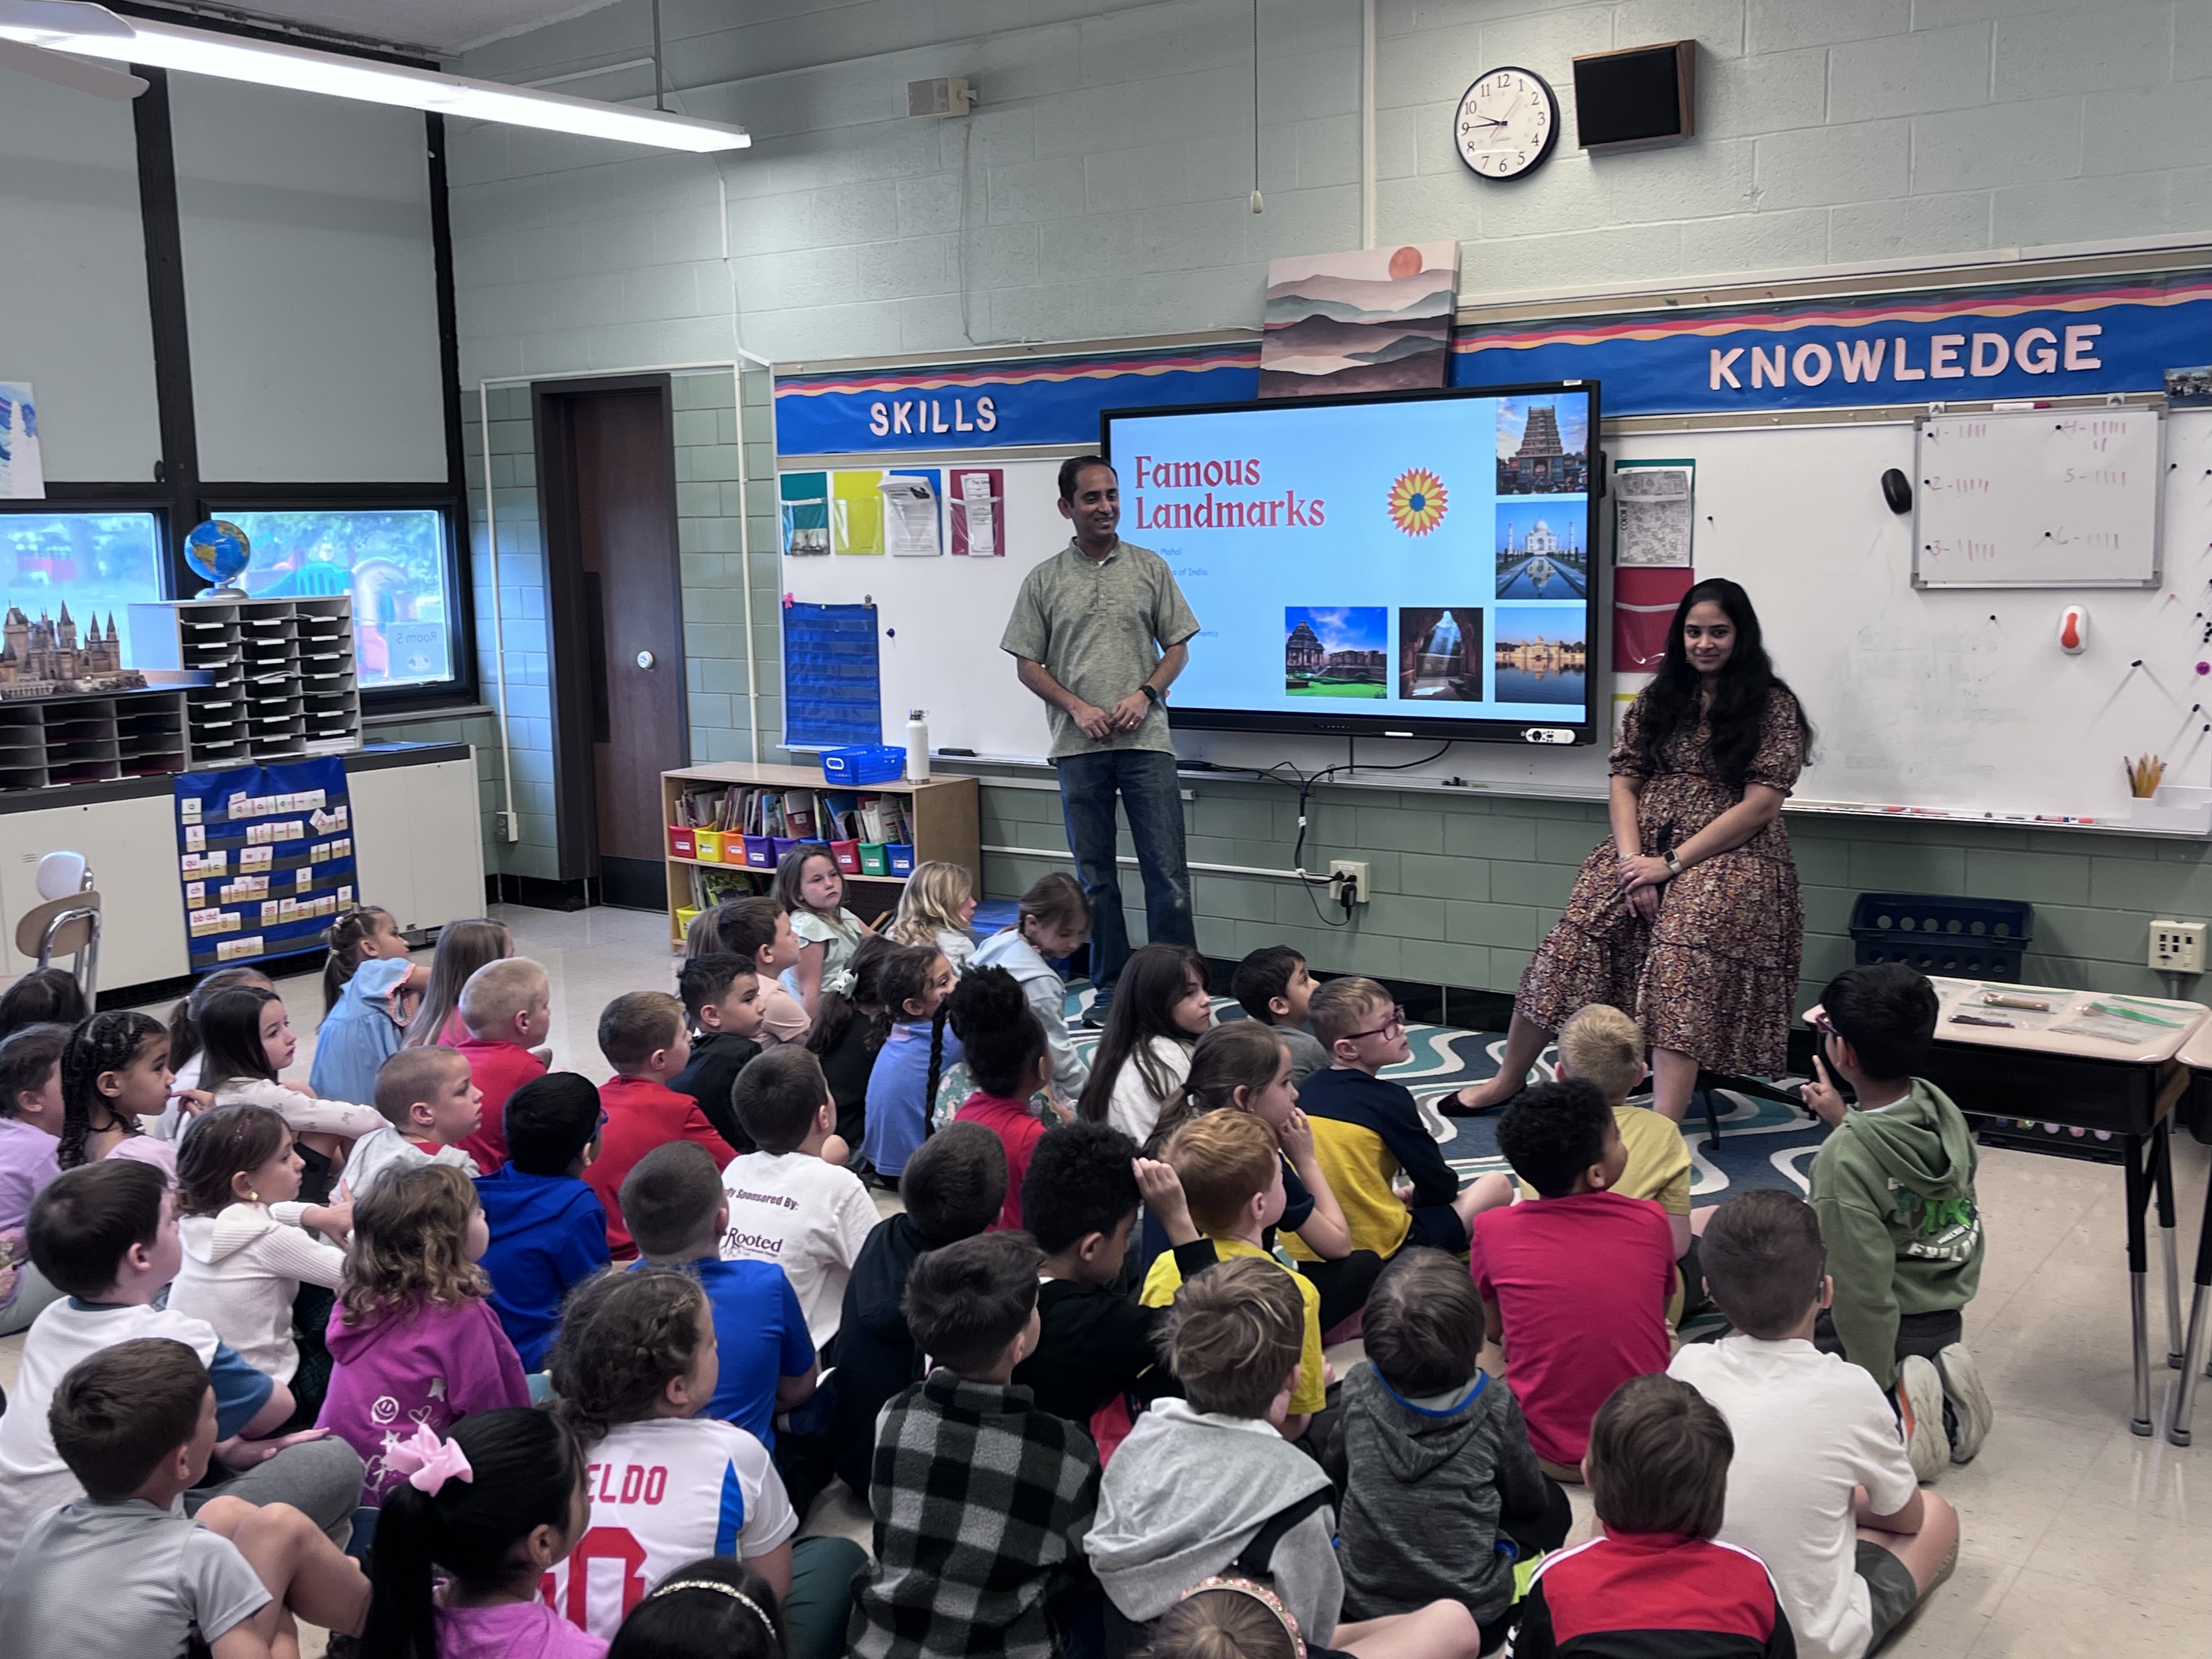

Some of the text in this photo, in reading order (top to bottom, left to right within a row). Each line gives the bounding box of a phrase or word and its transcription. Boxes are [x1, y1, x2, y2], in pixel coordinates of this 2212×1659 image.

[1497, 74, 1510, 88] 12
[1519, 79, 1524, 92] 1
[1481, 83, 1491, 97] 11
[1531, 92, 1539, 105] 2
[1465, 100, 1477, 115] 10
[1537, 112, 1545, 126] 3
[1461, 122, 1470, 137] 9
[1531, 133, 1539, 146] 4
[1466, 141, 1475, 156] 8
[1481, 156, 1490, 170] 7
[1499, 158, 1508, 172] 6
[1517, 151, 1525, 165] 5
[1709, 324, 2103, 391] KNOWLEDGE
[869, 396, 997, 437] SKILLS
[1135, 455, 1261, 489] Famous
[1135, 490, 1326, 530] Landmarks
[1160, 547, 1182, 555] Mahal
[1188, 567, 1207, 576] India
[736, 1189, 783, 1205] Sponsored
[783, 1197, 800, 1210] By:
[723, 1227, 784, 1252] Rooted
[585, 1463, 668, 1505] ELDO
